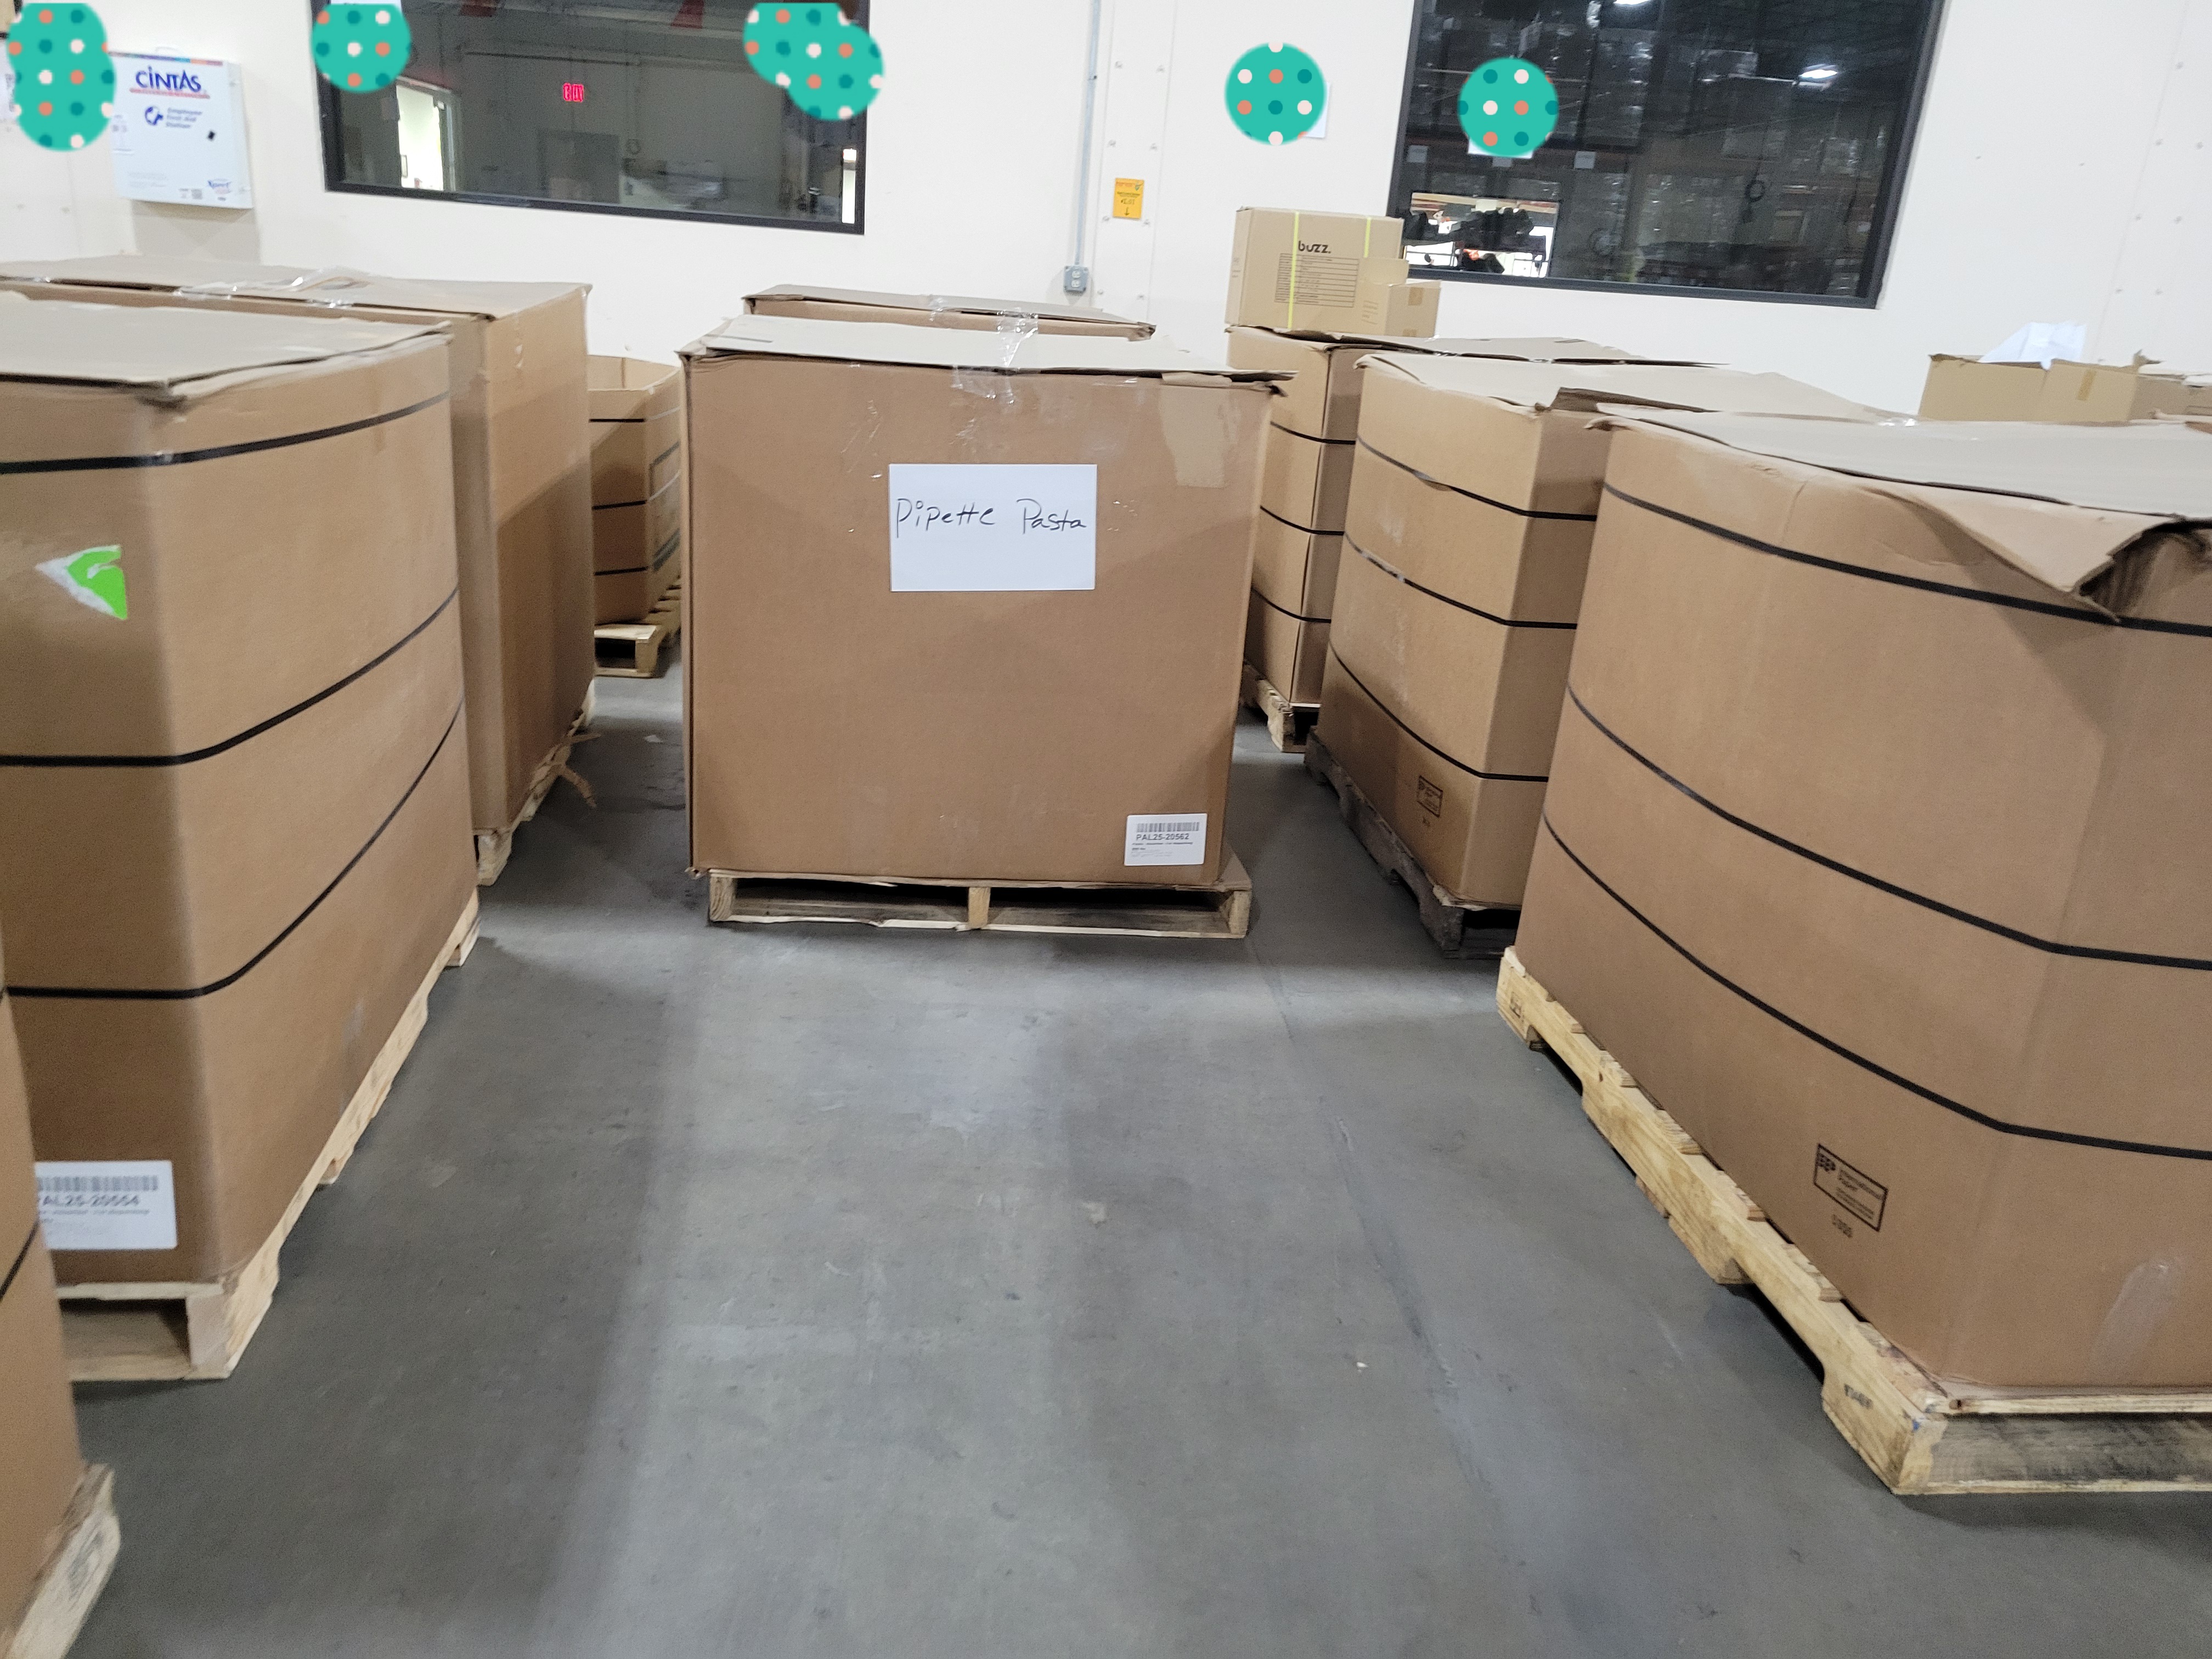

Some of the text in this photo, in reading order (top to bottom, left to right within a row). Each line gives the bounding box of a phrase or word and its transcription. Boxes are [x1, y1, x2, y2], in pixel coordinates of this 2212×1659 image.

[896, 498, 1087, 538] Pipette Pasta
[1135, 833, 1190, 841] PAL25-20562
[38, 1194, 139, 1207] AL25-20554
